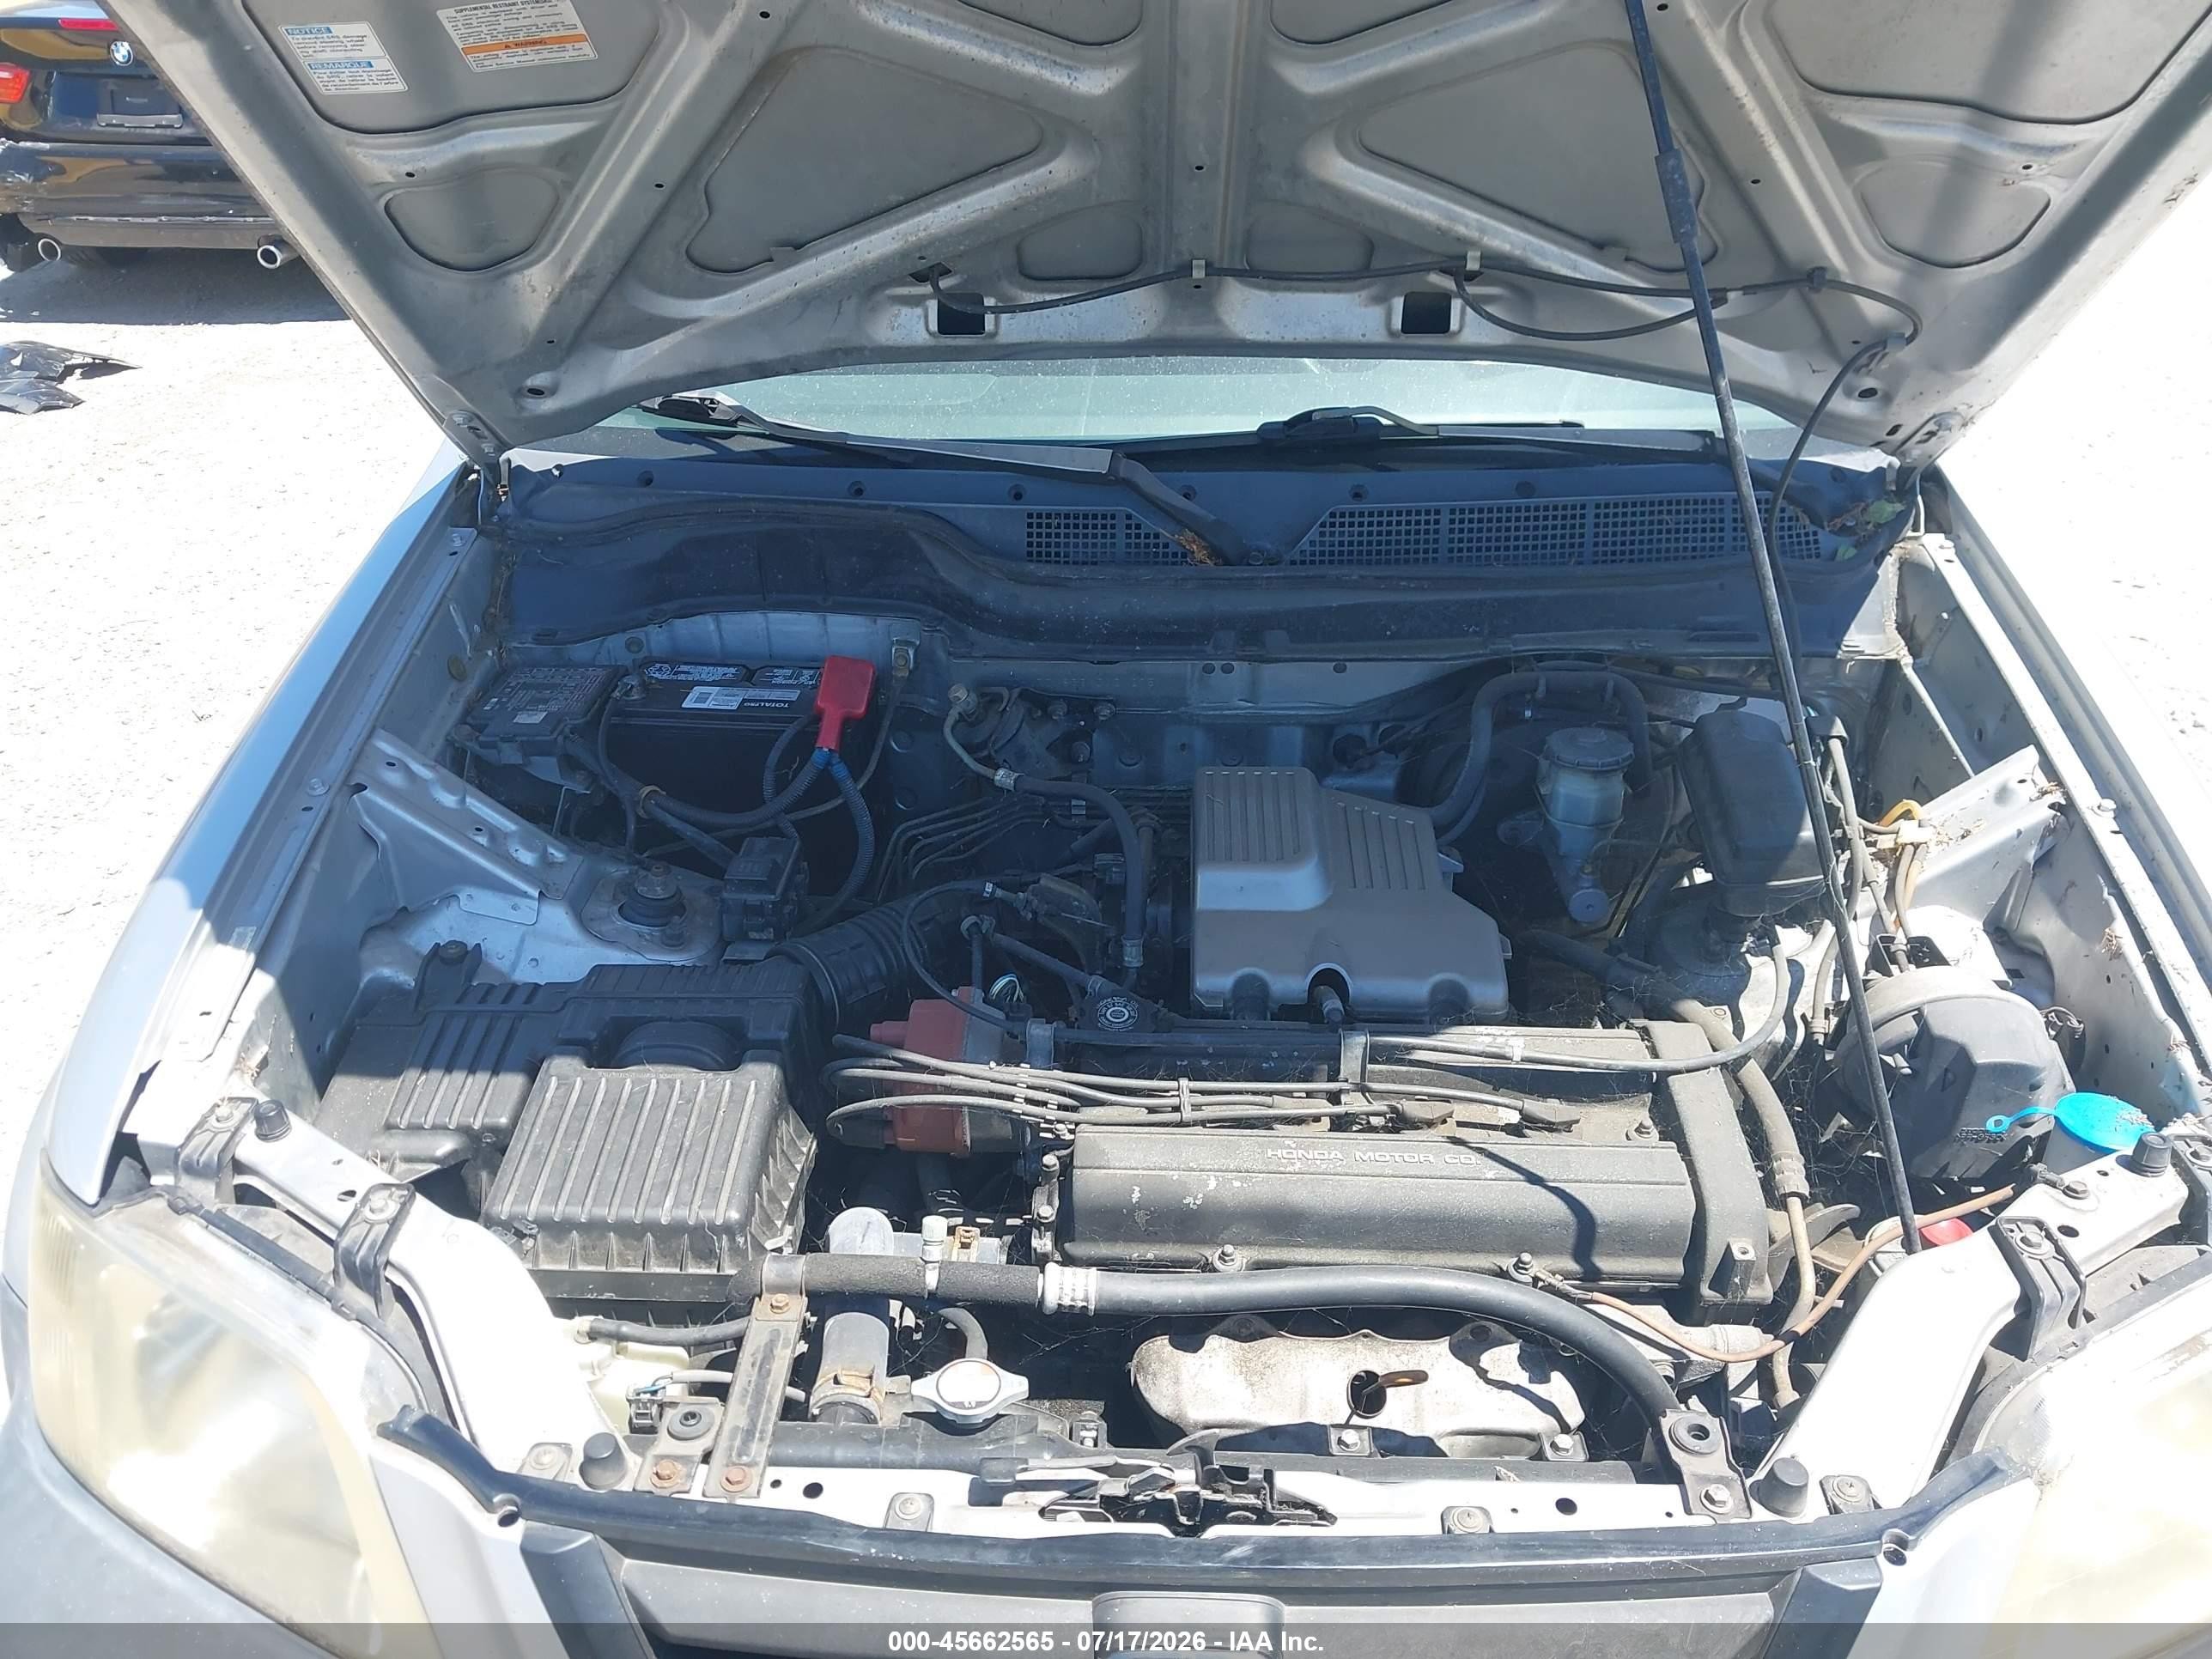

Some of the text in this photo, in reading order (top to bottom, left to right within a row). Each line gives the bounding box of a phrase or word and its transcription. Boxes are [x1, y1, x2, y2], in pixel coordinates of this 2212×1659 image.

[288, 27, 329, 35] NOTICE
[309, 61, 369, 70] REMARQUE
[1266, 1148, 1481, 1166] HONDA MOTOR CO.
